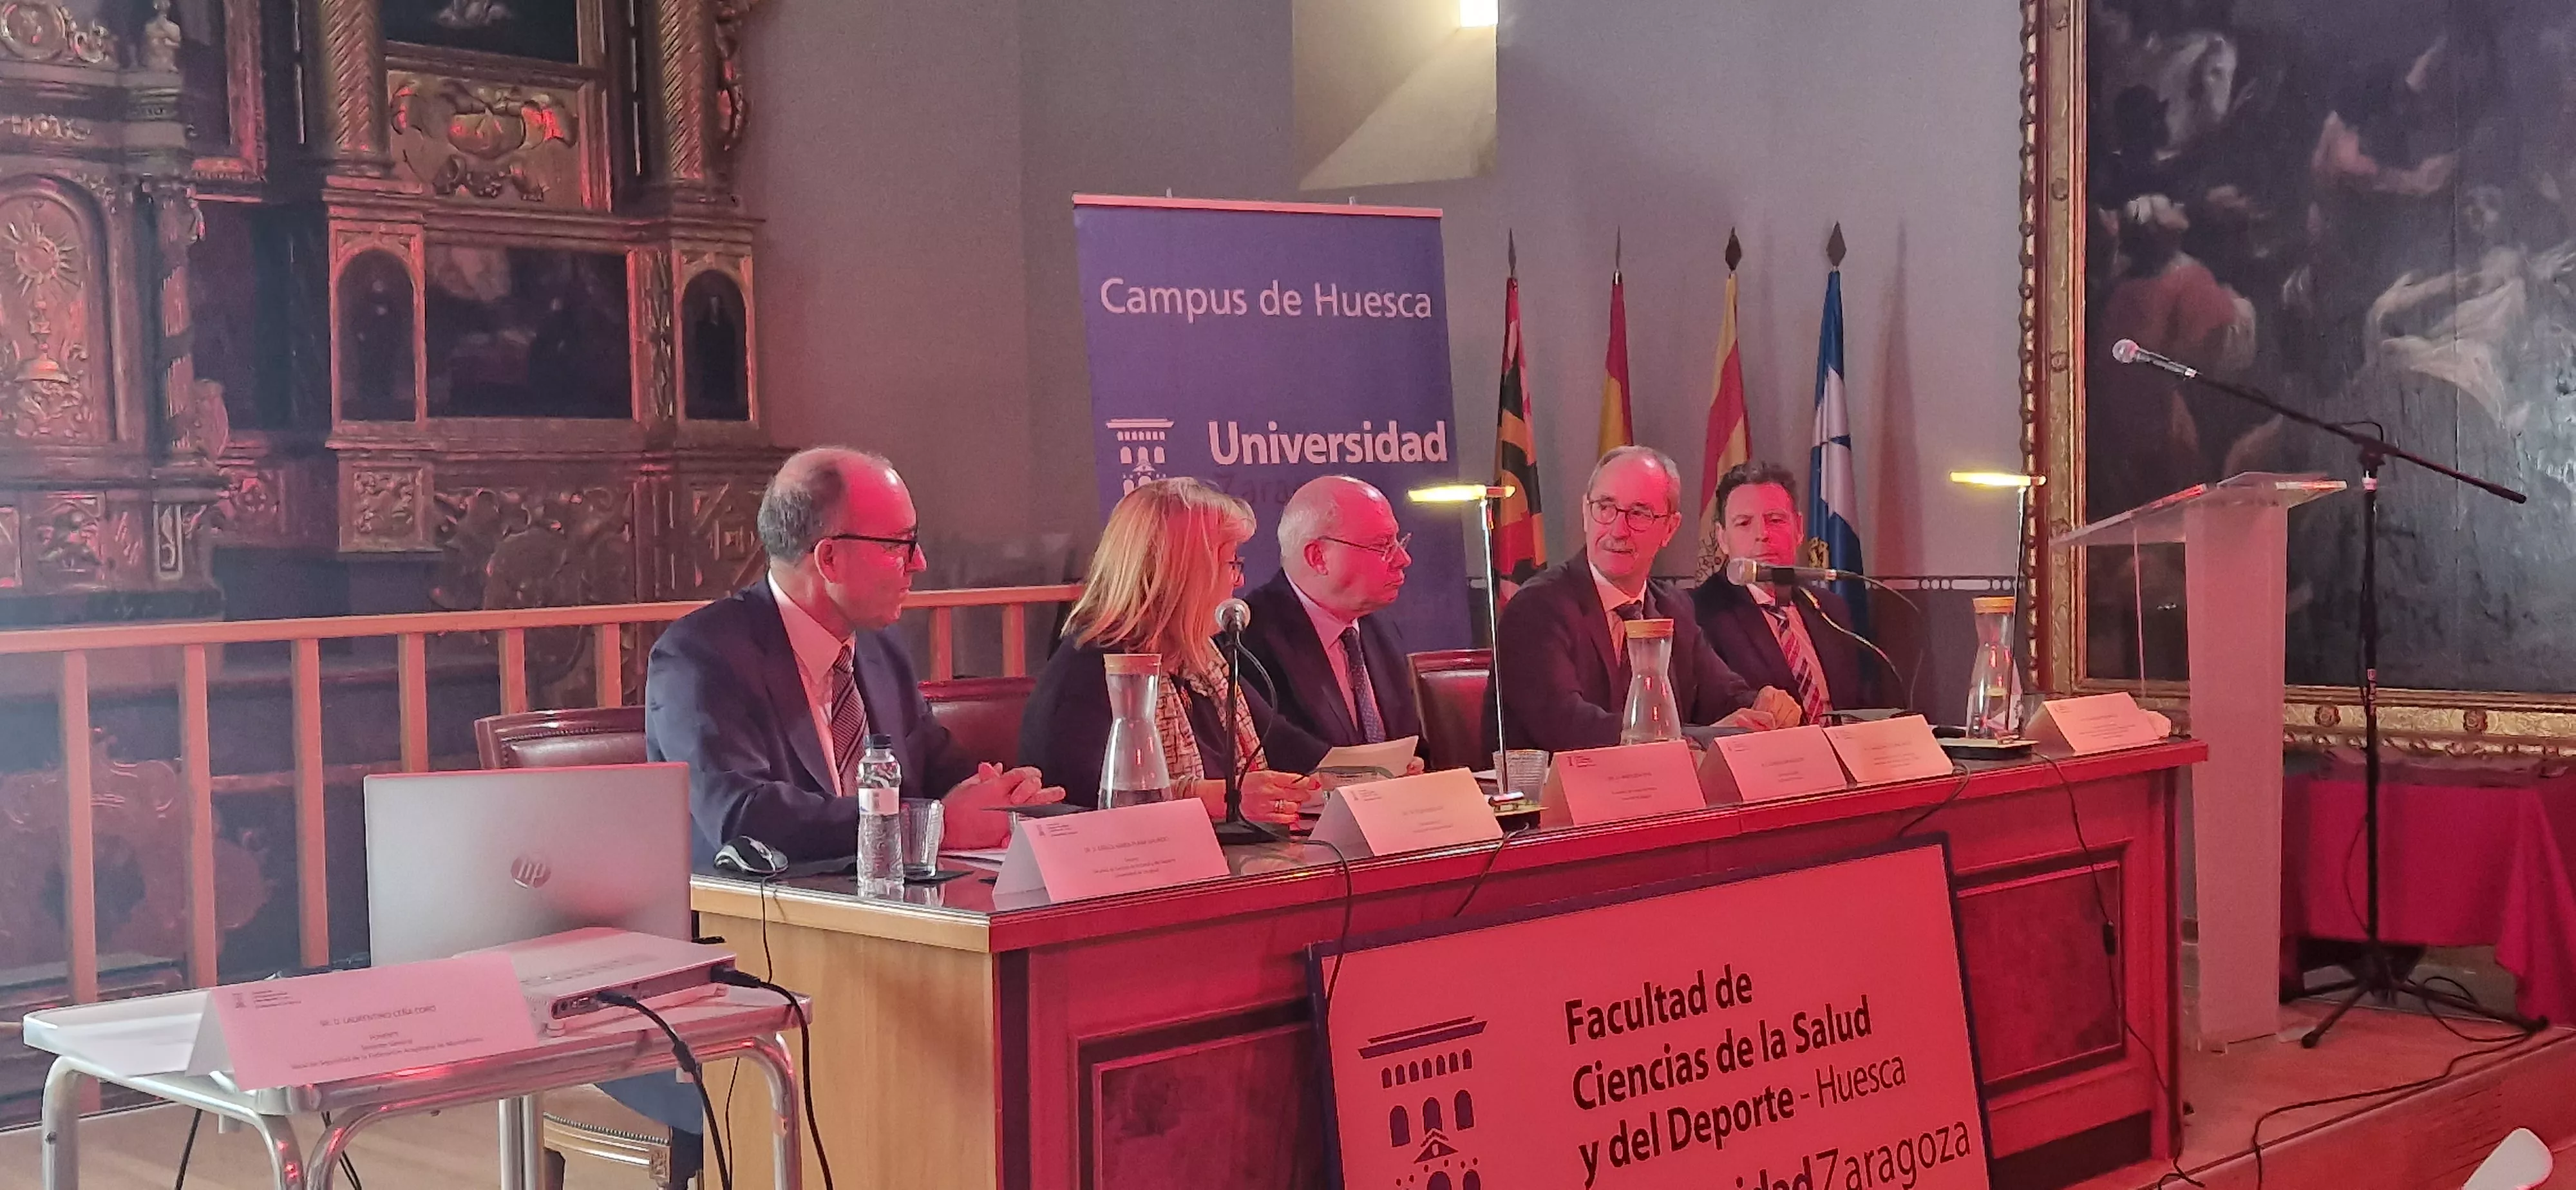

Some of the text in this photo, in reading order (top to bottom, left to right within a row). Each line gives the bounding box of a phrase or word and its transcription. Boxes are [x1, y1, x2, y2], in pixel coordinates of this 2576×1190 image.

[1100, 278, 1433, 323] Campus de Huesca
[1208, 420, 1448, 465] Universidad
[516, 856, 547, 885] hp
[1564, 963, 1753, 1045] Facultad de
[1573, 994, 1872, 1110] Ciencias de la Salud
[1578, 1140, 1600, 1190] y
[1609, 1111, 1661, 1168] del
[1667, 1085, 1795, 1151] Deporte
[1815, 1056, 1907, 1108] Huesca
